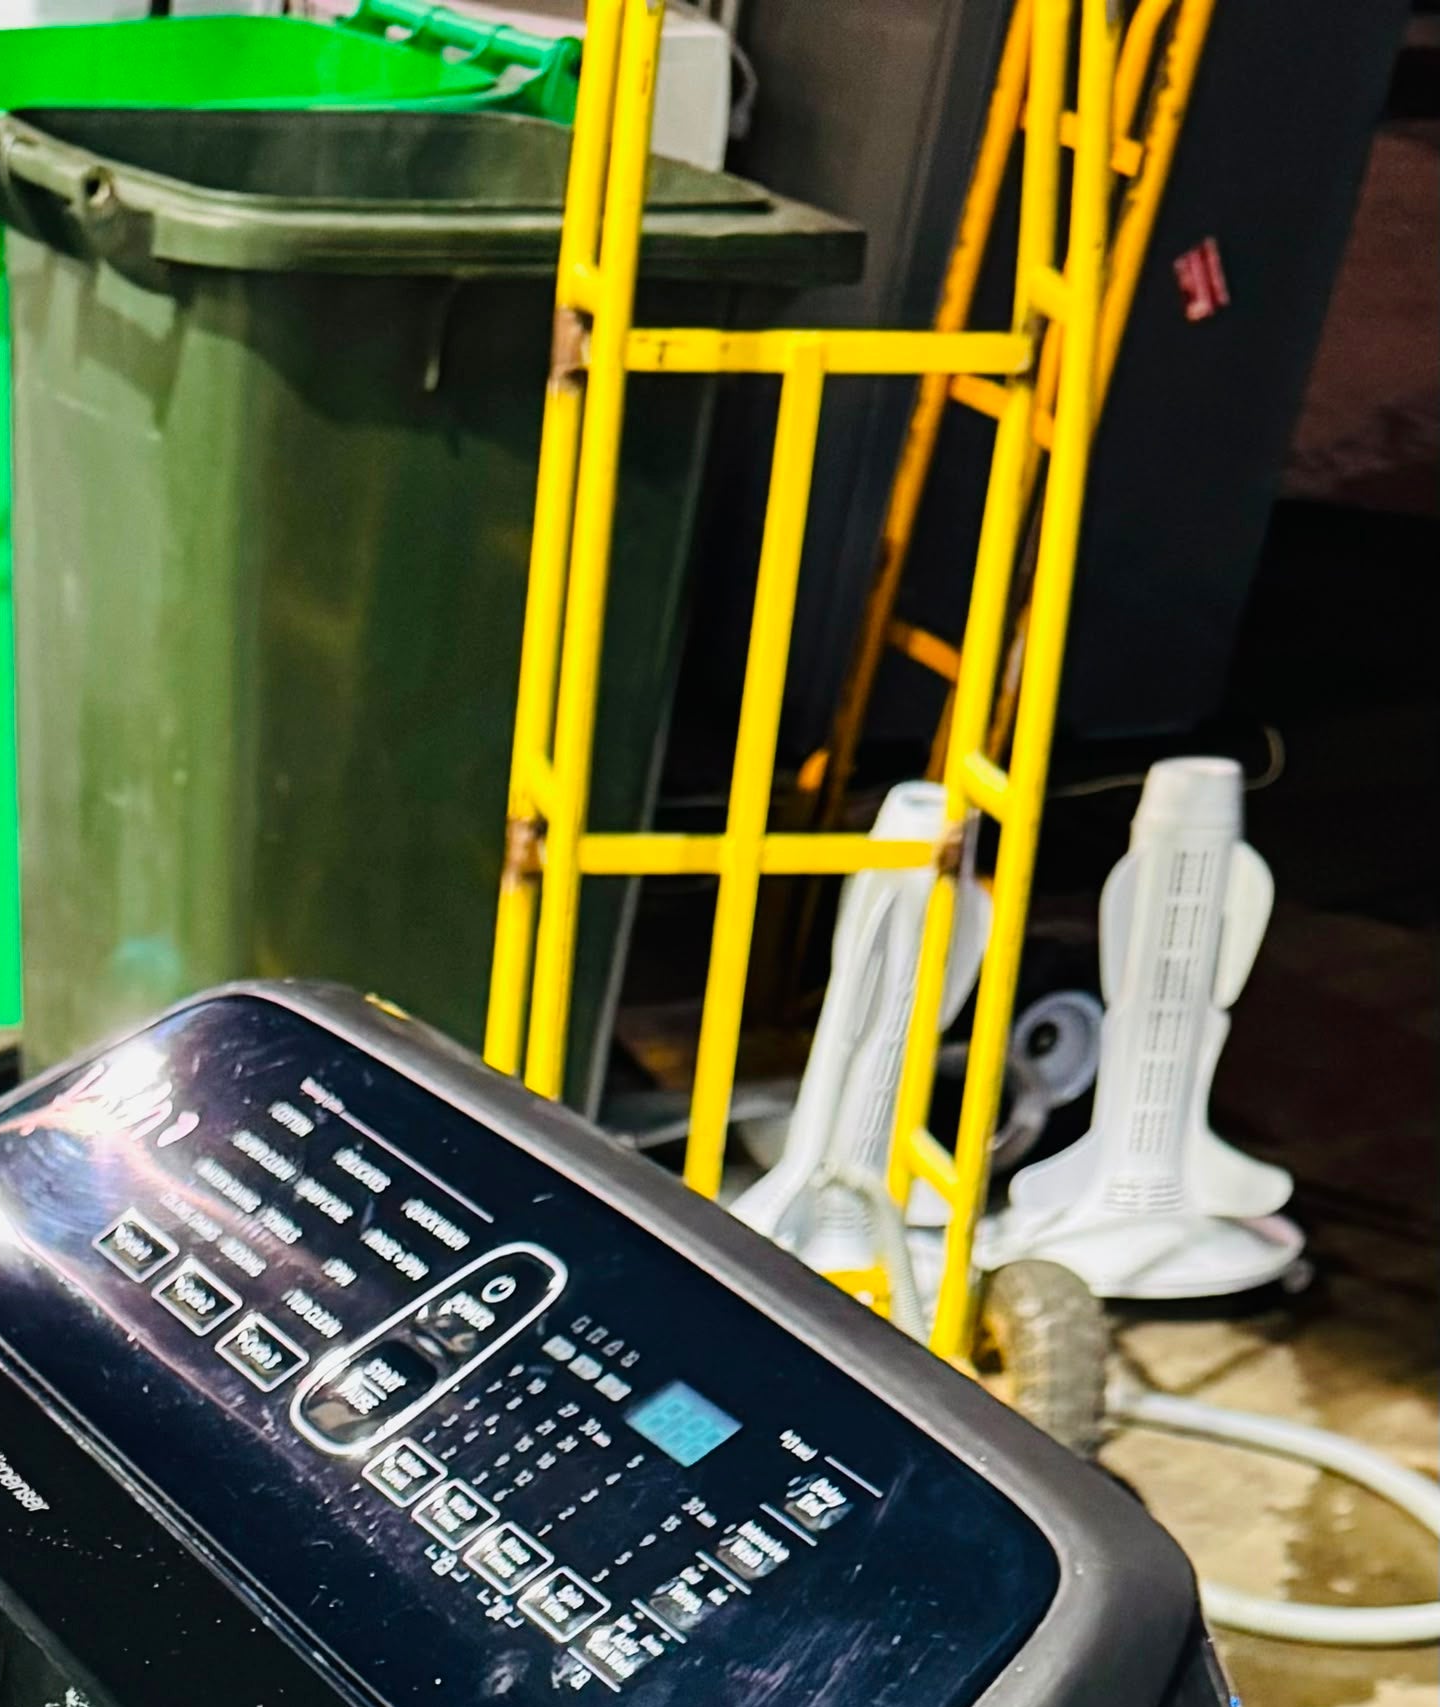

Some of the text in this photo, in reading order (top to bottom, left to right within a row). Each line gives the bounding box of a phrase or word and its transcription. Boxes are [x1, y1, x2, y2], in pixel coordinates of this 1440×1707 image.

[450, 1291, 495, 1331] POWER
[364, 1358, 407, 1392] START
[681, 1496, 706, 1515] 30
[797, 1492, 828, 1517] End
[810, 1477, 847, 1508] Delay
[660, 1514, 682, 1532] 15
[730, 1539, 764, 1568] Wash
[668, 1581, 703, 1614] Temp.
